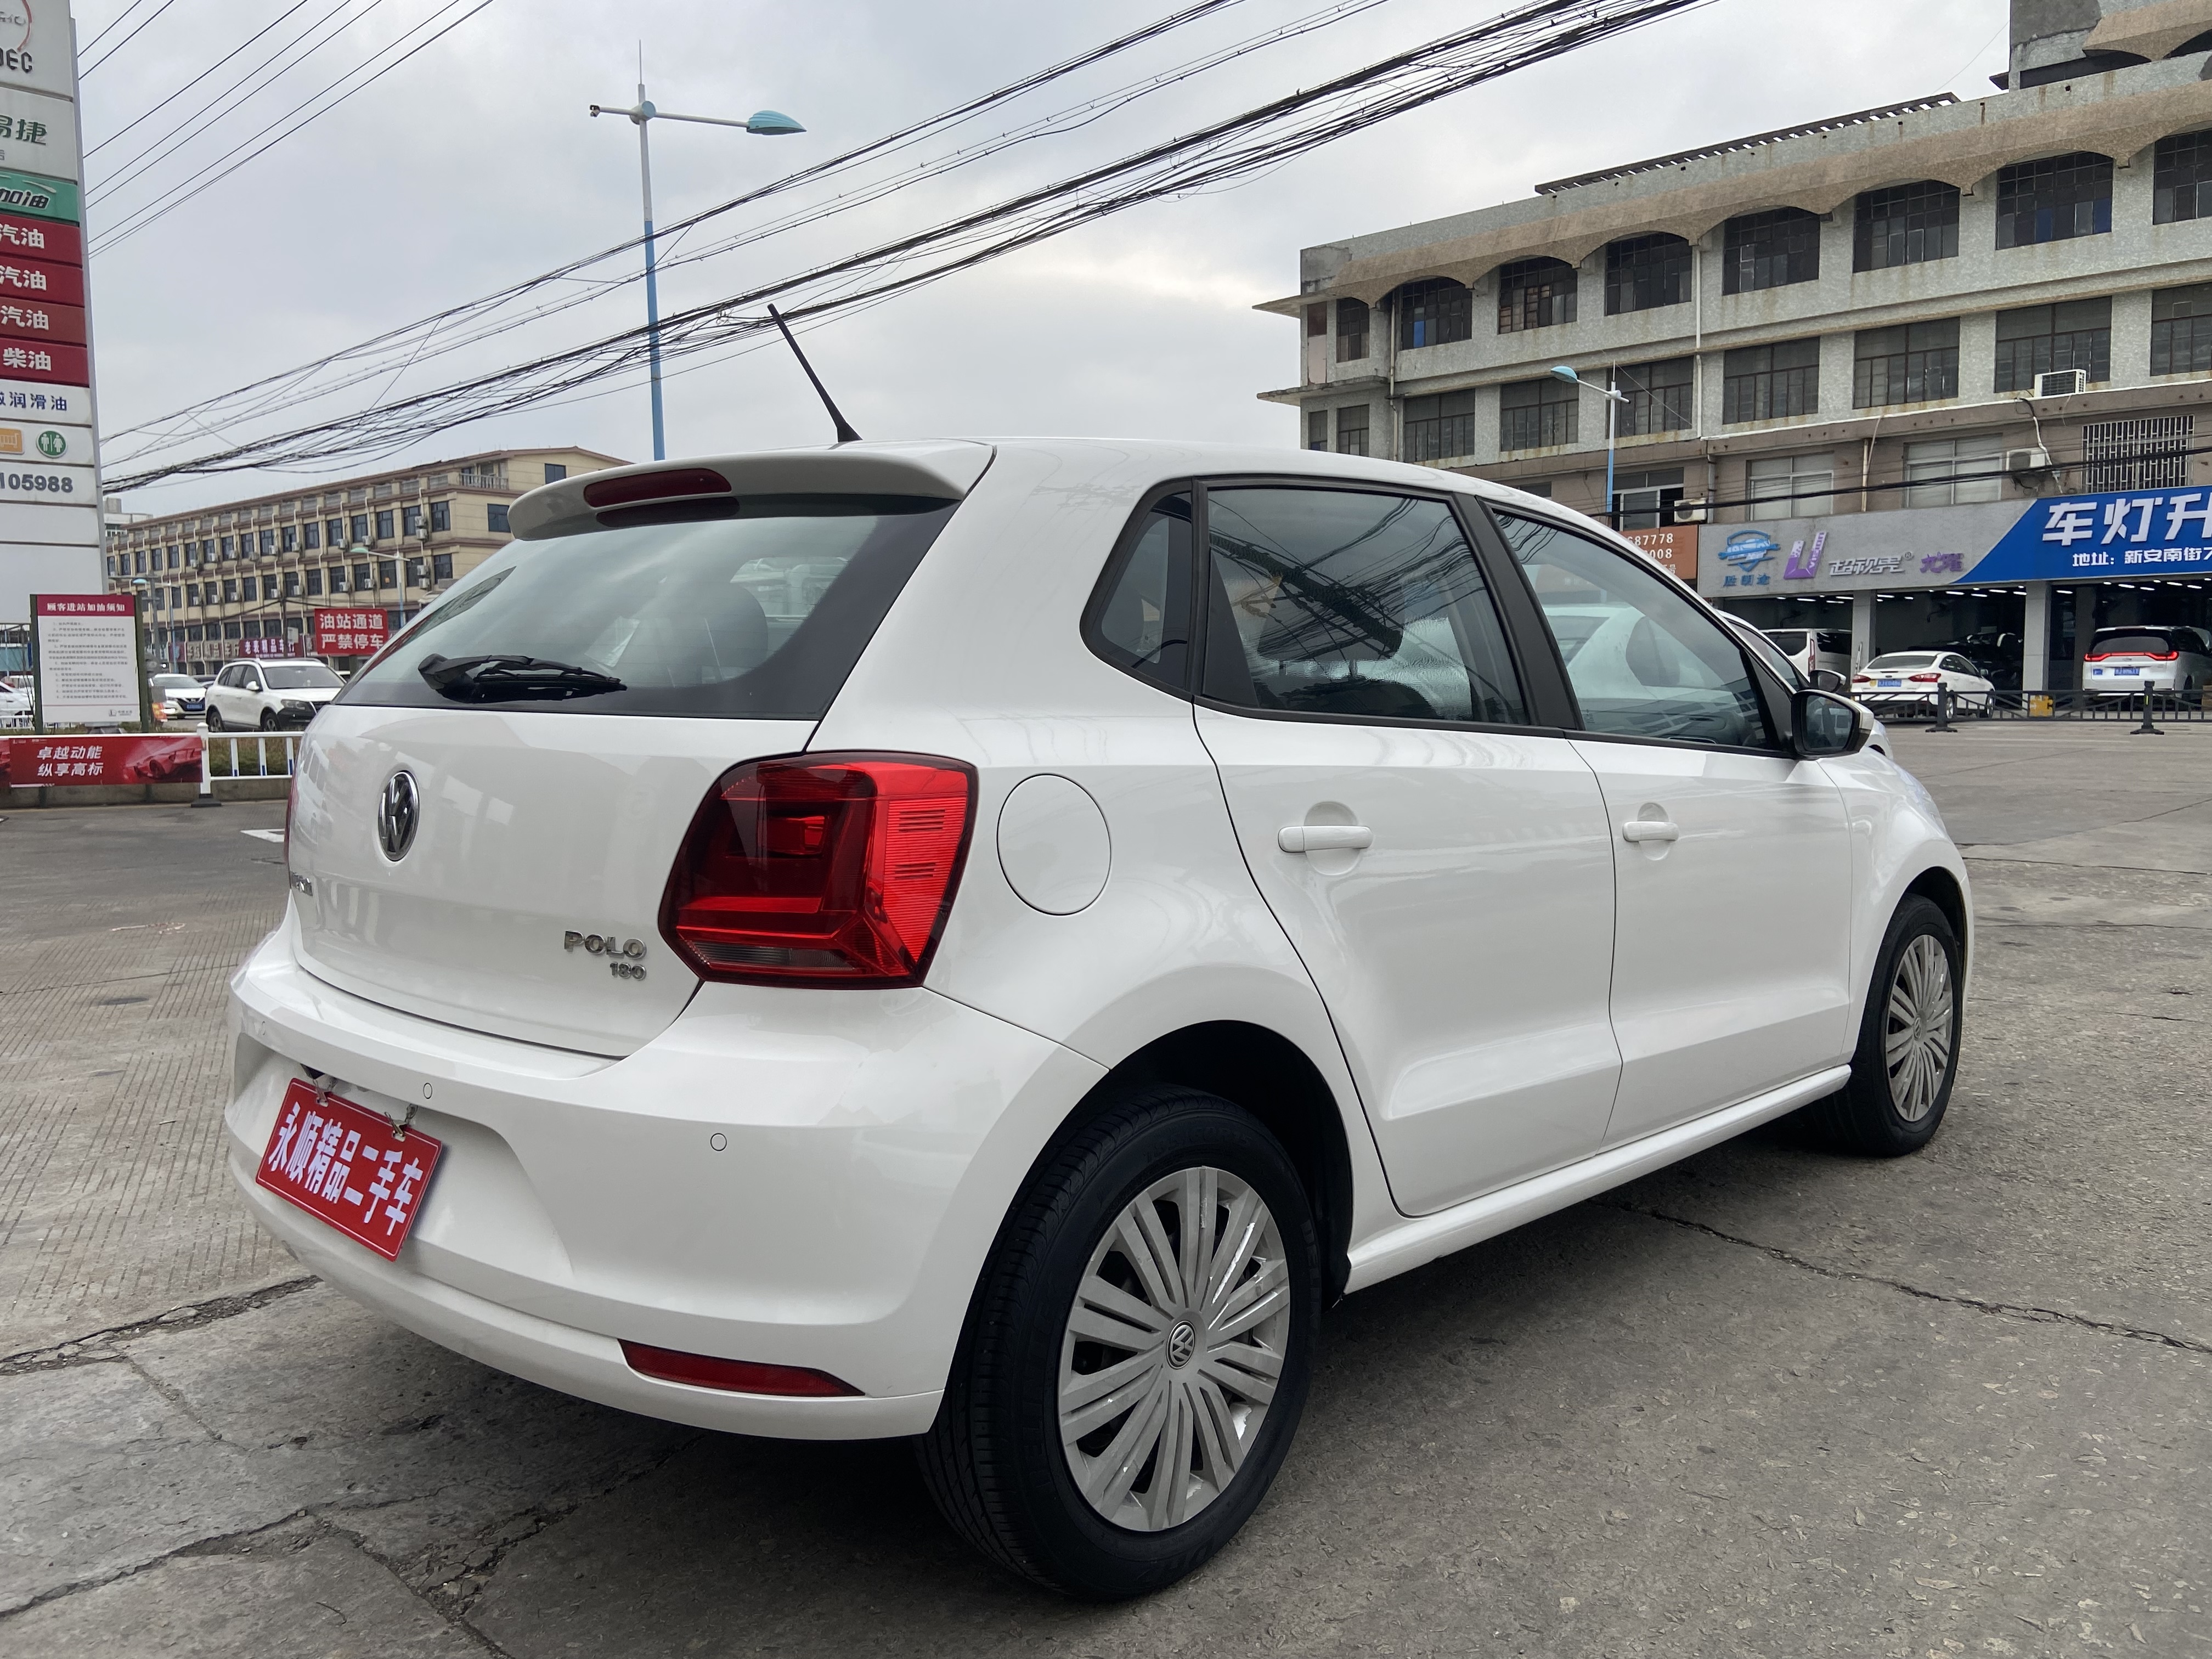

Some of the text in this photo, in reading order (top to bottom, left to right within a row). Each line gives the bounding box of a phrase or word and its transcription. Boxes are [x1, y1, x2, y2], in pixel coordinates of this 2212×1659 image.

[0, 223, 45, 249] 汽油
[0, 265, 47, 291] 汽油
[0, 305, 49, 330] 汽油
[3, 347, 52, 371] 柴油
[1644, 548, 1672, 559] 008
[320, 613, 383, 629] 油站通道
[321, 633, 383, 649] 严禁停车
[37, 745, 103, 760] 卓越动能
[37, 762, 104, 777] 纵享高标
[564, 930, 648, 960] POLO
[610, 962, 646, 981] 180
[268, 1101, 423, 1236] 永顺精品二手车
